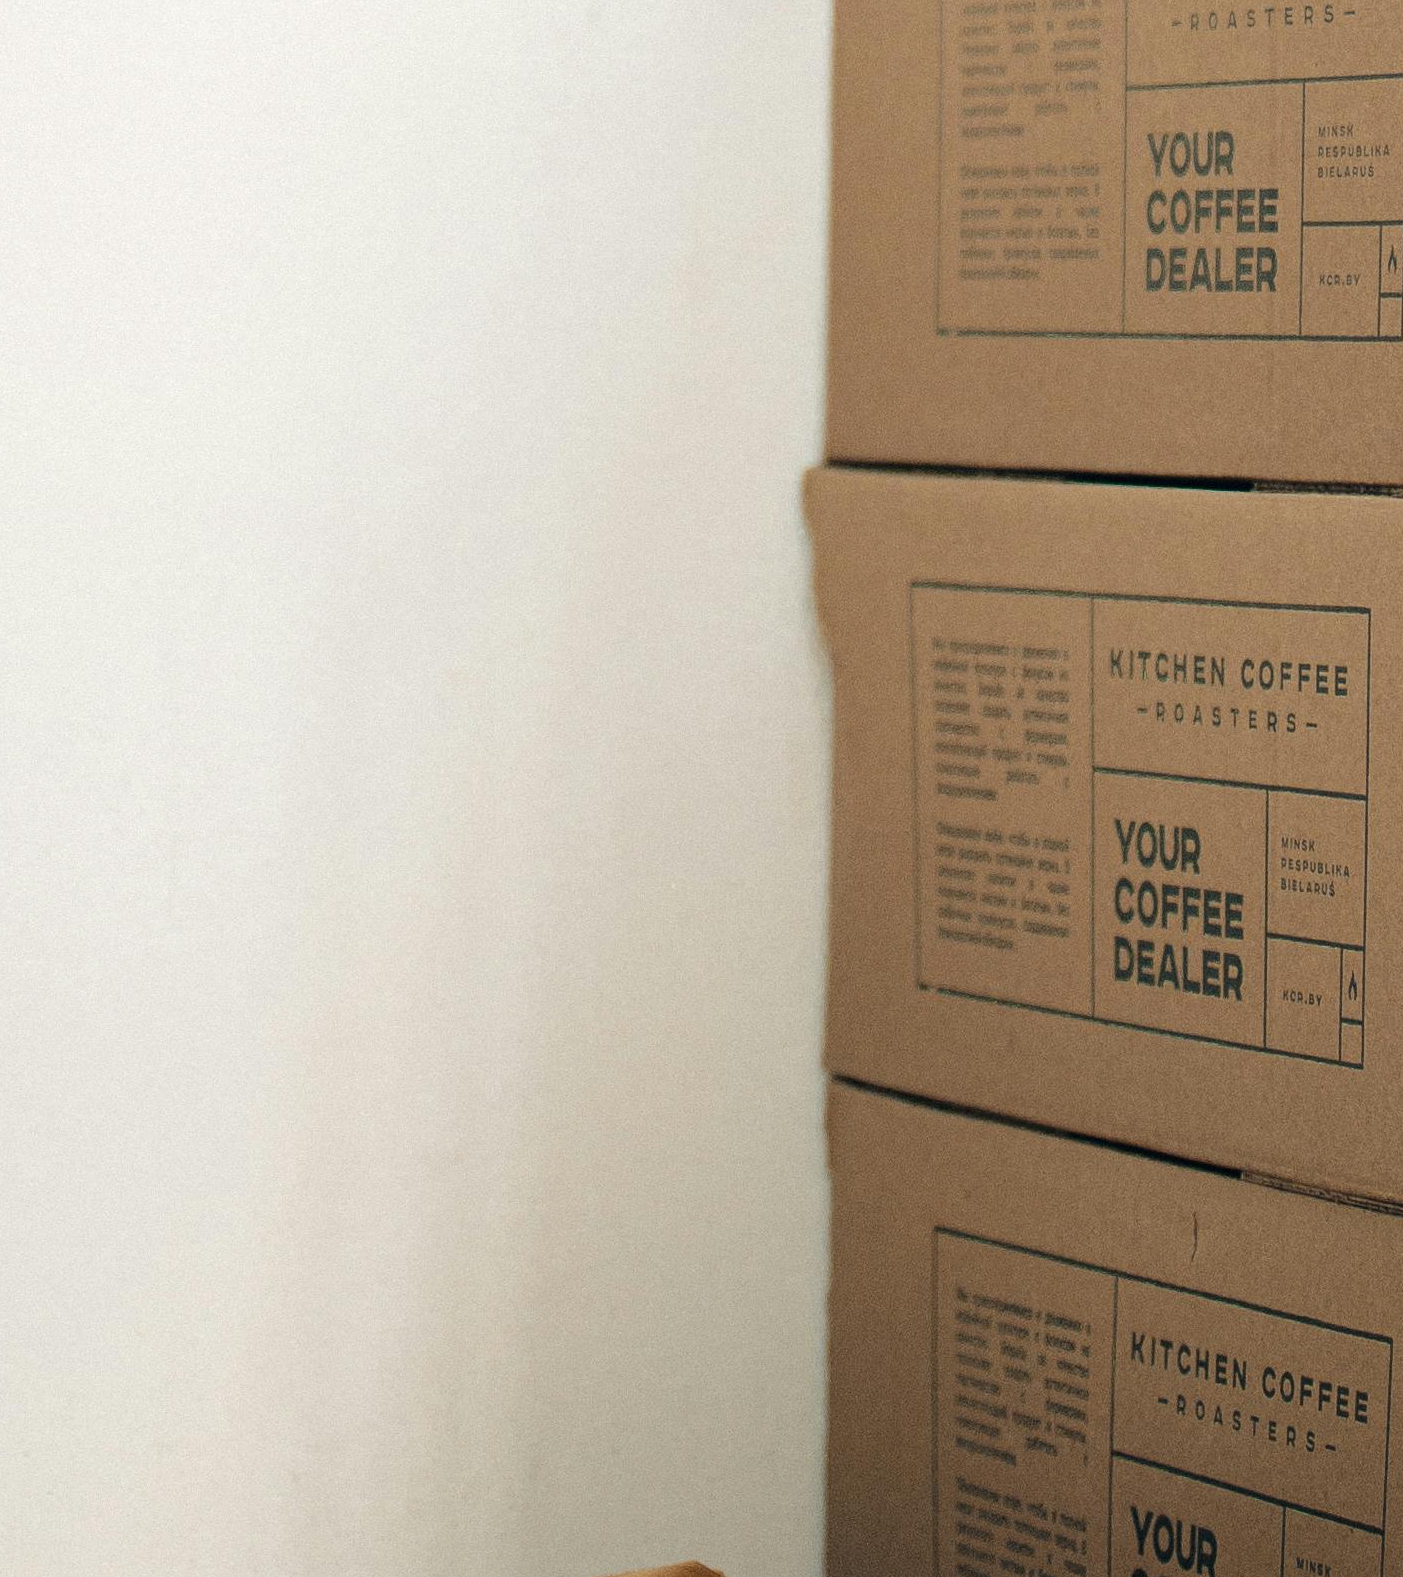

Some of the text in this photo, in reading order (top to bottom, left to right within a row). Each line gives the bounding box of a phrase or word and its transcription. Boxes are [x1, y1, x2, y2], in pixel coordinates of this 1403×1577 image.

[1146, 129, 1234, 176] YOUR
[1146, 187, 1279, 234] COFFEE
[1145, 246, 1277, 292] DEALER
[1109, 648, 1348, 696] KITCHEN COFFEE
[1113, 818, 1201, 874] YOUR
[1113, 876, 1244, 940] COFFEE
[1113, 935, 1243, 1001] DEALER
[1130, 1331, 1368, 1424] KITCHEN COFFEE
[1129, 1504, 1217, 1577] YOUR
